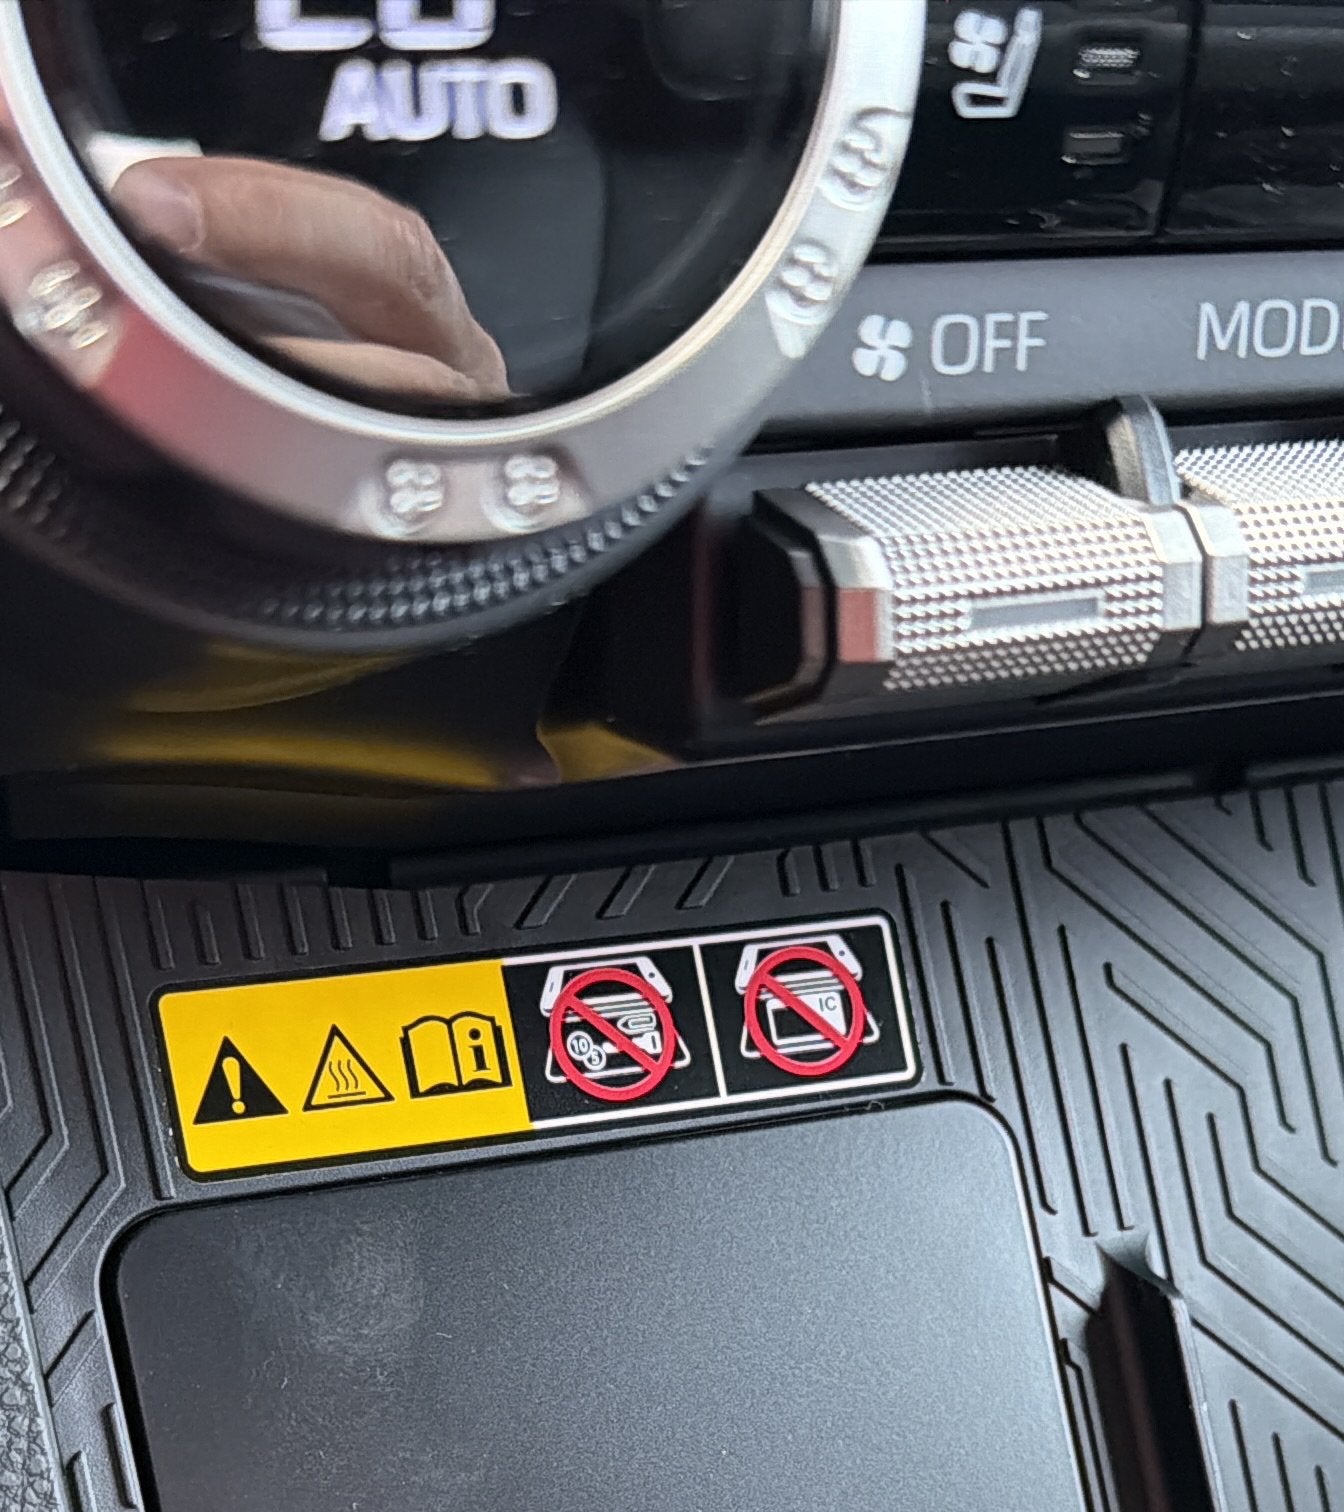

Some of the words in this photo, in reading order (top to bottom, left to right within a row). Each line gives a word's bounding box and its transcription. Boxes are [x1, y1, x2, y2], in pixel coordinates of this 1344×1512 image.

[318, 57, 558, 141] AUTO
[930, 311, 1048, 376] OFF
[819, 996, 838, 1013] IC
[570, 1036, 588, 1054] 10
